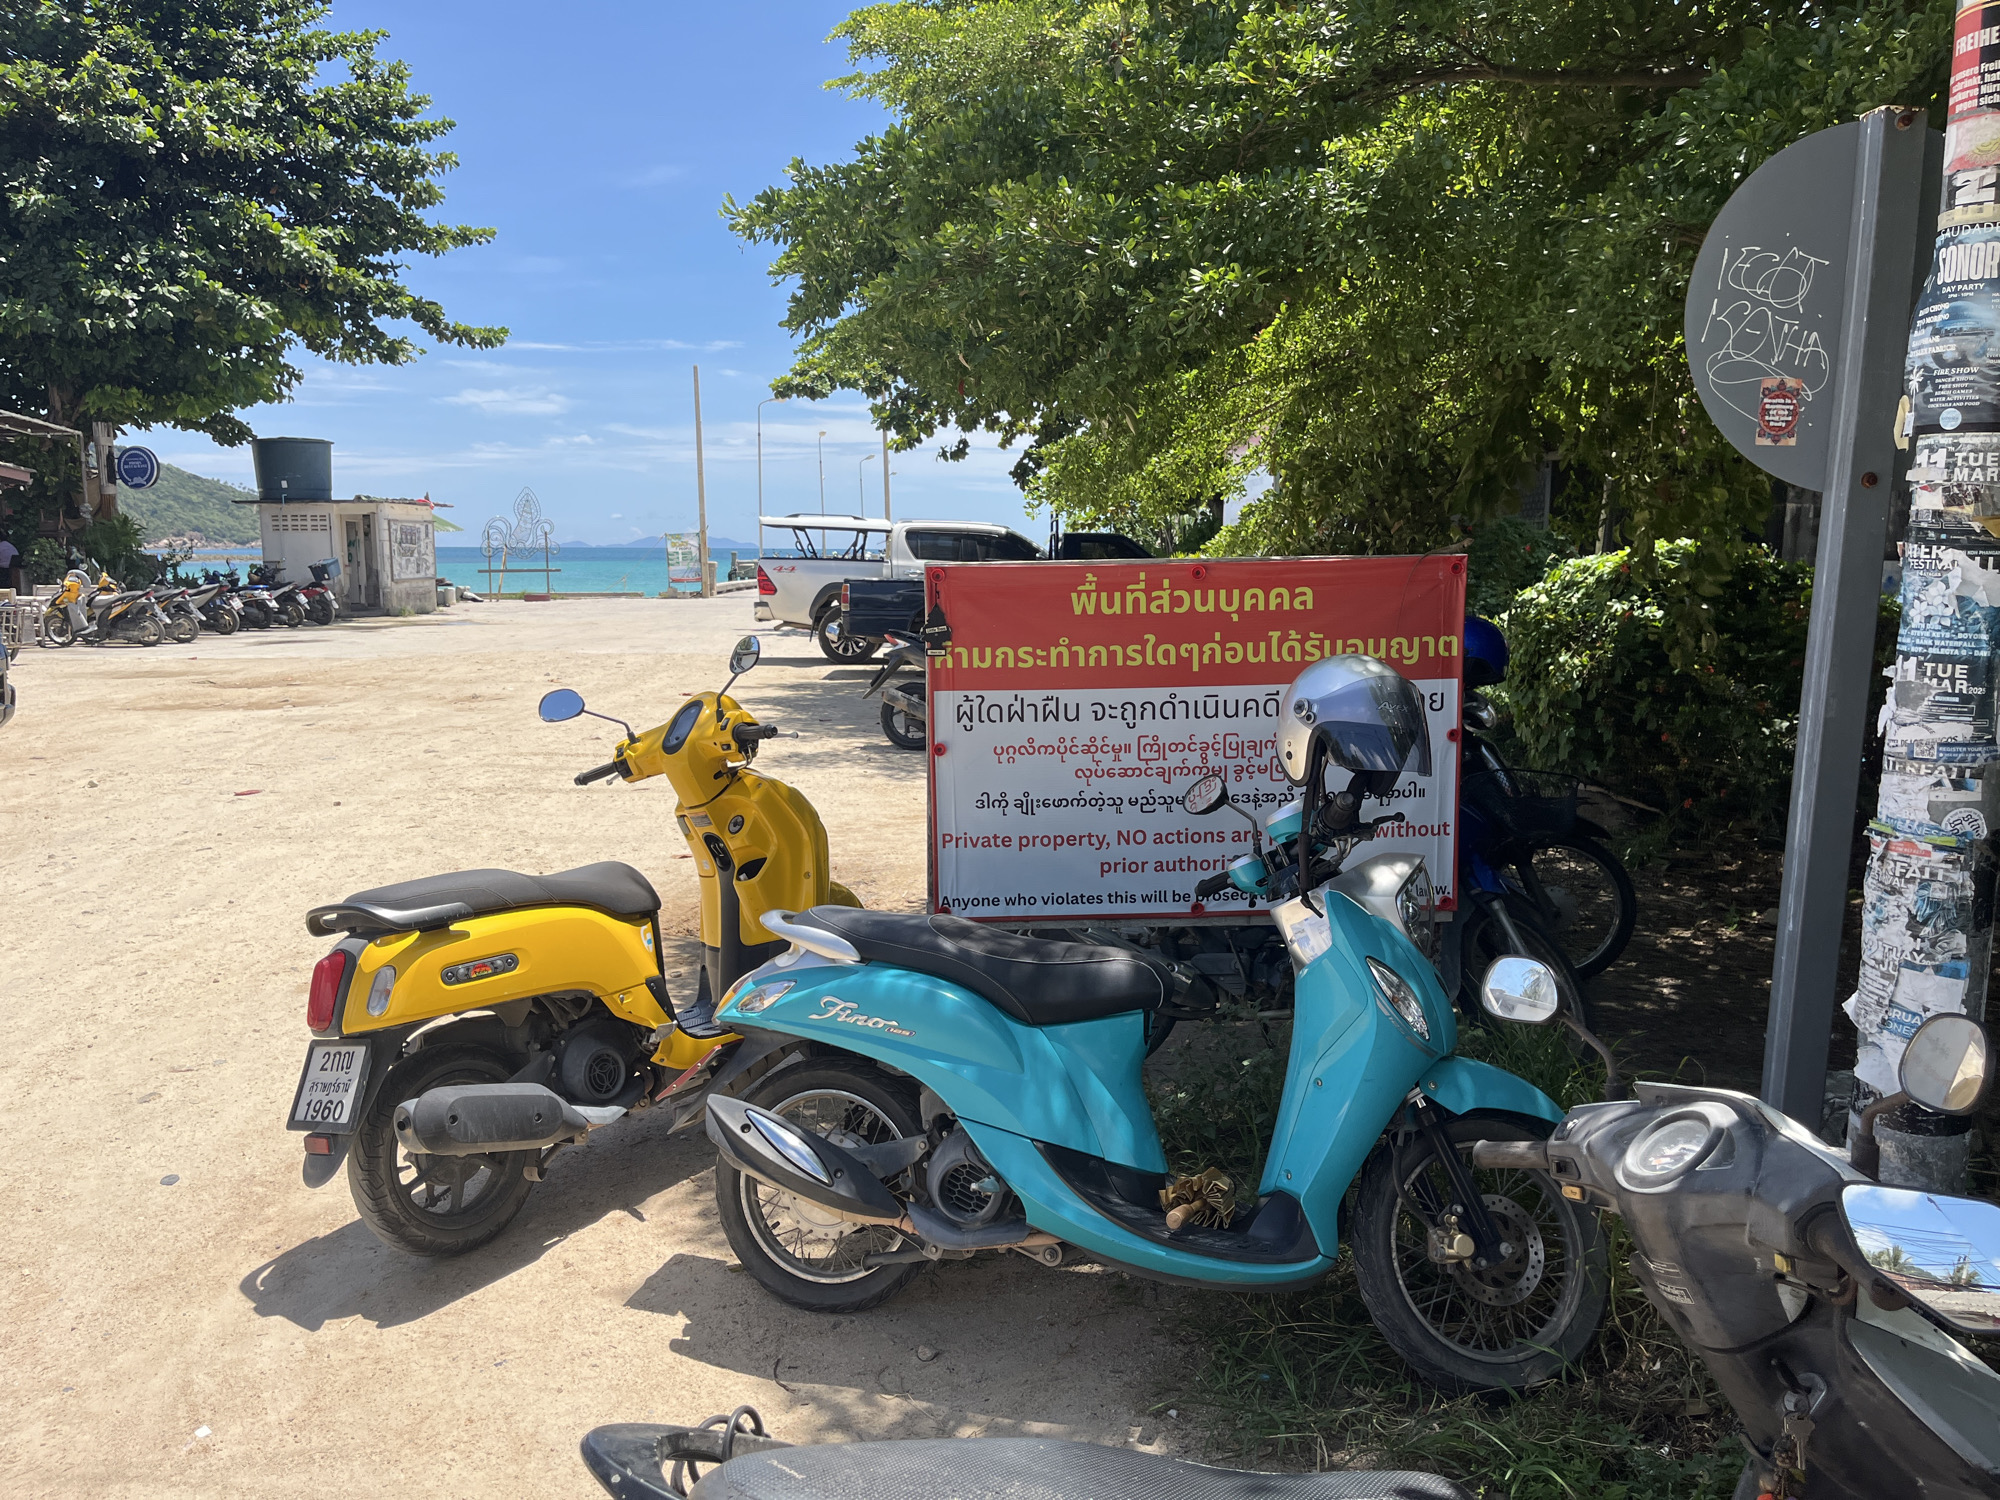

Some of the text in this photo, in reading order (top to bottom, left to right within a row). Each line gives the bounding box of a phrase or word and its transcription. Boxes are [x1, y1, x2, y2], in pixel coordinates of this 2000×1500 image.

[1942, 282, 1985, 294] DAY PARTY
[1934, 366, 1979, 376] FIRE SHOW
[1955, 452, 2000, 466] TUE
[1954, 467, 1998, 481] MAR
[1070, 571, 1314, 622] พื้นที่ส่วนบุคคล
[933, 630, 1458, 672] หามกระทำการใดๆก่อนได้รับอนญาต
[1924, 662, 1968, 679] TUE
[1923, 678, 1968, 694] MAR
[956, 694, 1081, 732] ผู้ใดฝ่าฝืน
[941, 832, 1012, 849] Private
[1018, 830, 1111, 851] property,
[1116, 829, 1147, 846] NO
[1152, 828, 1226, 845] actions
[1231, 828, 1262, 842] are
[1375, 822, 1450, 839] without
[1100, 855, 1233, 877] prior authori
[940, 892, 1000, 910] Anyone
[1004, 892, 1037, 906] who
[1041, 891, 1104, 906] violates
[1107, 890, 1136, 904] this
[1140, 890, 1168, 903] will
[1172, 890, 1191, 902] be
[808, 995, 898, 1028] Fino
[319, 1050, 355, 1074] 2กญ
[308, 1078, 352, 1096] สุราษฎร์ธานี
[304, 1099, 345, 1121] 1960
